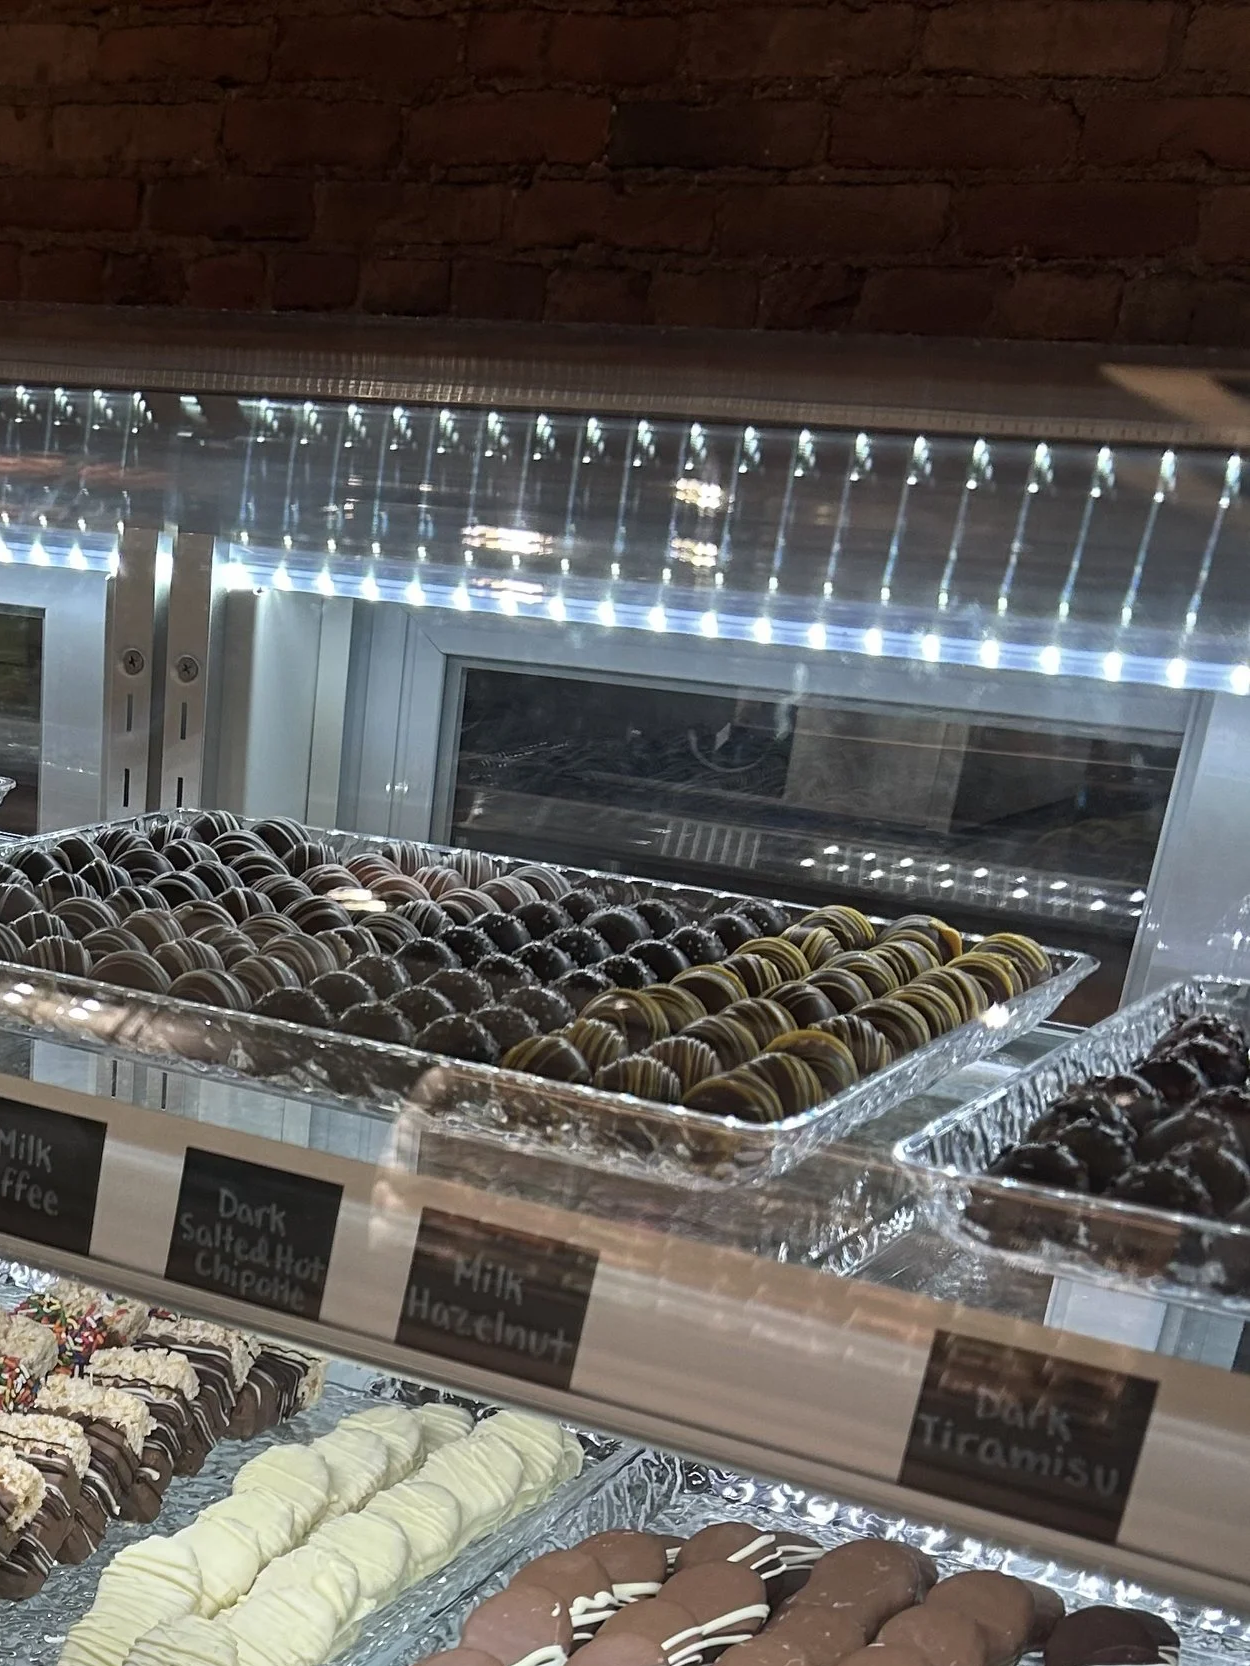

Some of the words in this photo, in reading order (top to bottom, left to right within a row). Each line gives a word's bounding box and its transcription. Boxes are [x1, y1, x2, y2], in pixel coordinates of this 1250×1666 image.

[219, 1187, 286, 1237] Dark
[179, 1212, 270, 1268] Salted
[275, 1243, 325, 1283] Hot
[454, 1250, 523, 1306] Milk
[194, 1250, 305, 1311] Chipotle
[406, 1284, 572, 1364] Hazelnut
[975, 1386, 1074, 1441] Dark
[917, 1413, 1121, 1497] Tiramisu
